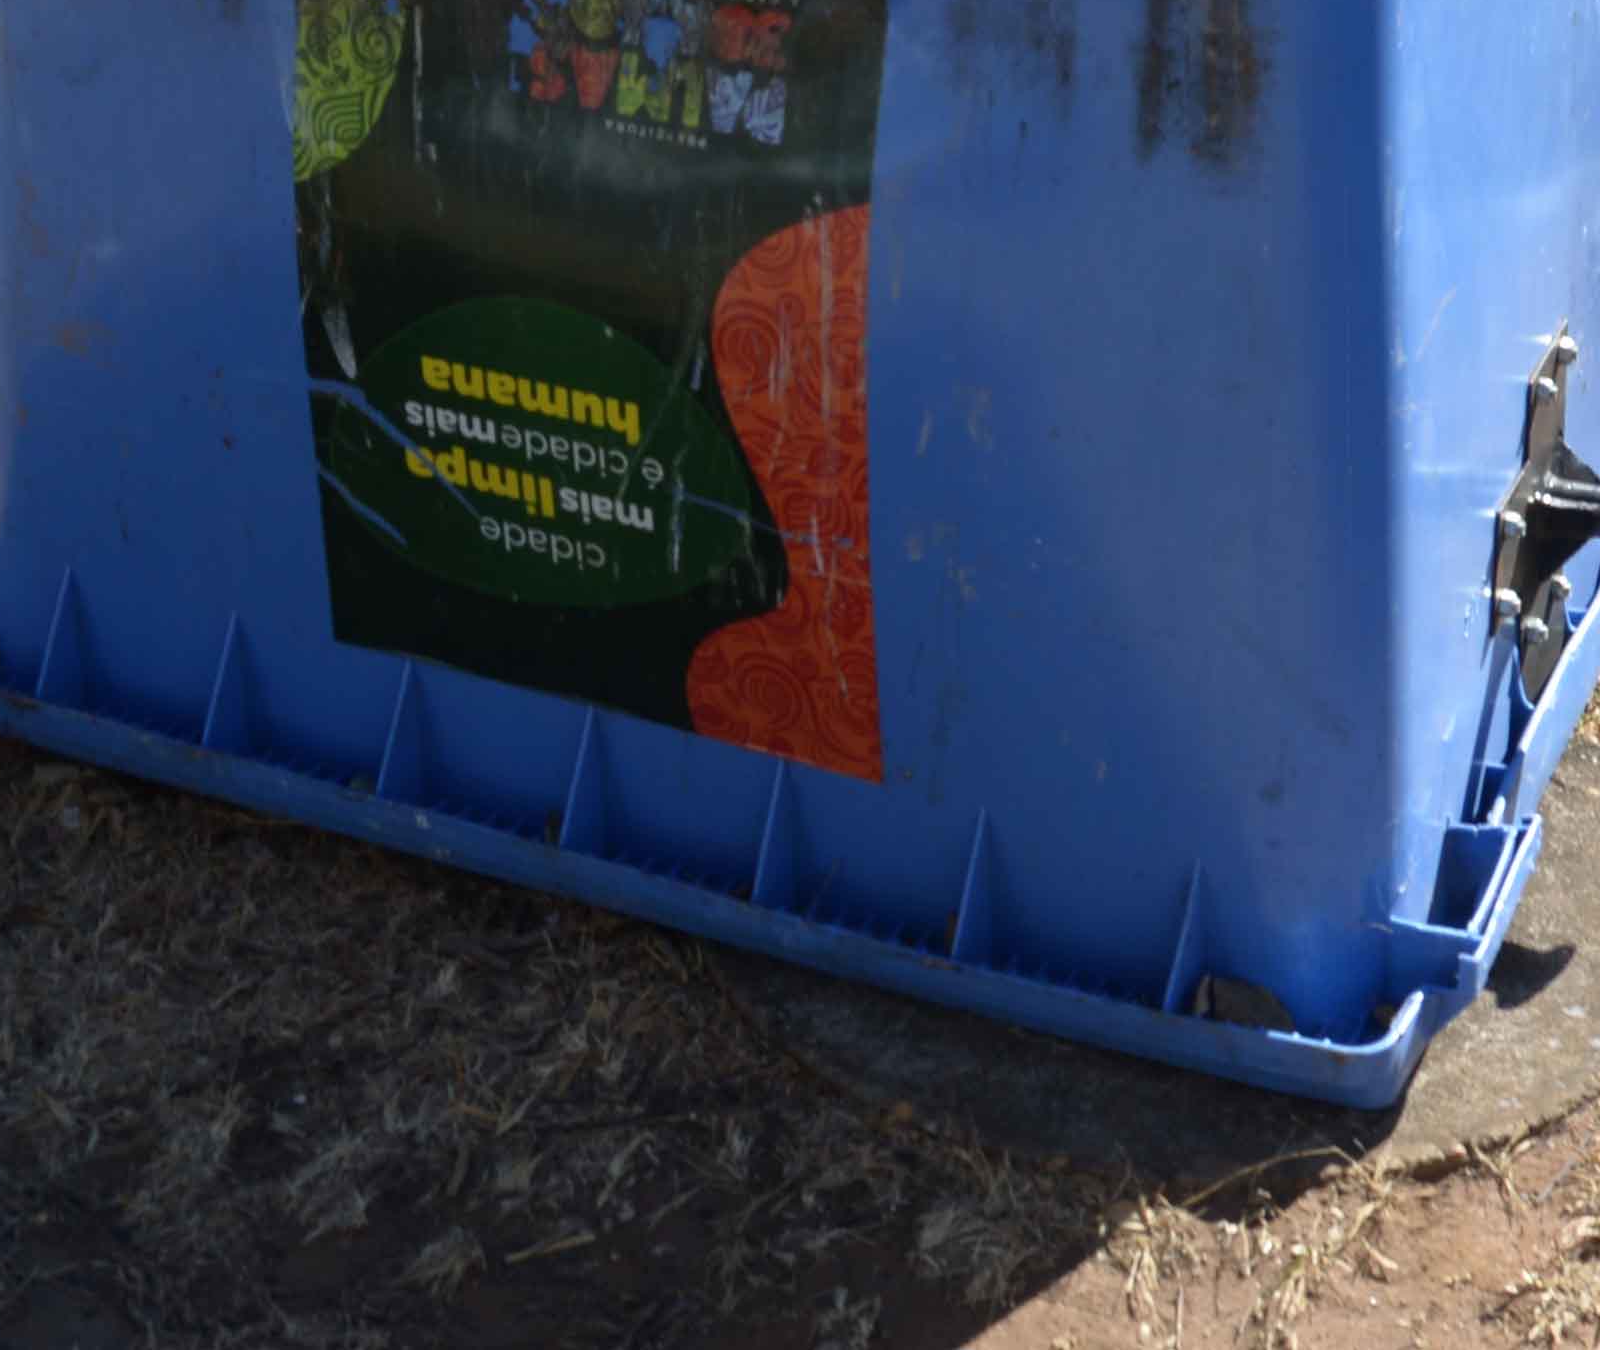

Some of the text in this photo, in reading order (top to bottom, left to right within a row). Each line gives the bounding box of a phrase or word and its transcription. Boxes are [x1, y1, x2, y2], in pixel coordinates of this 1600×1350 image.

[404, 399, 497, 444] mais
[420, 355, 641, 447] humana
[500, 424, 629, 478] cidade
[404, 446, 655, 531] mais limpa
[479, 515, 607, 571] cidade
